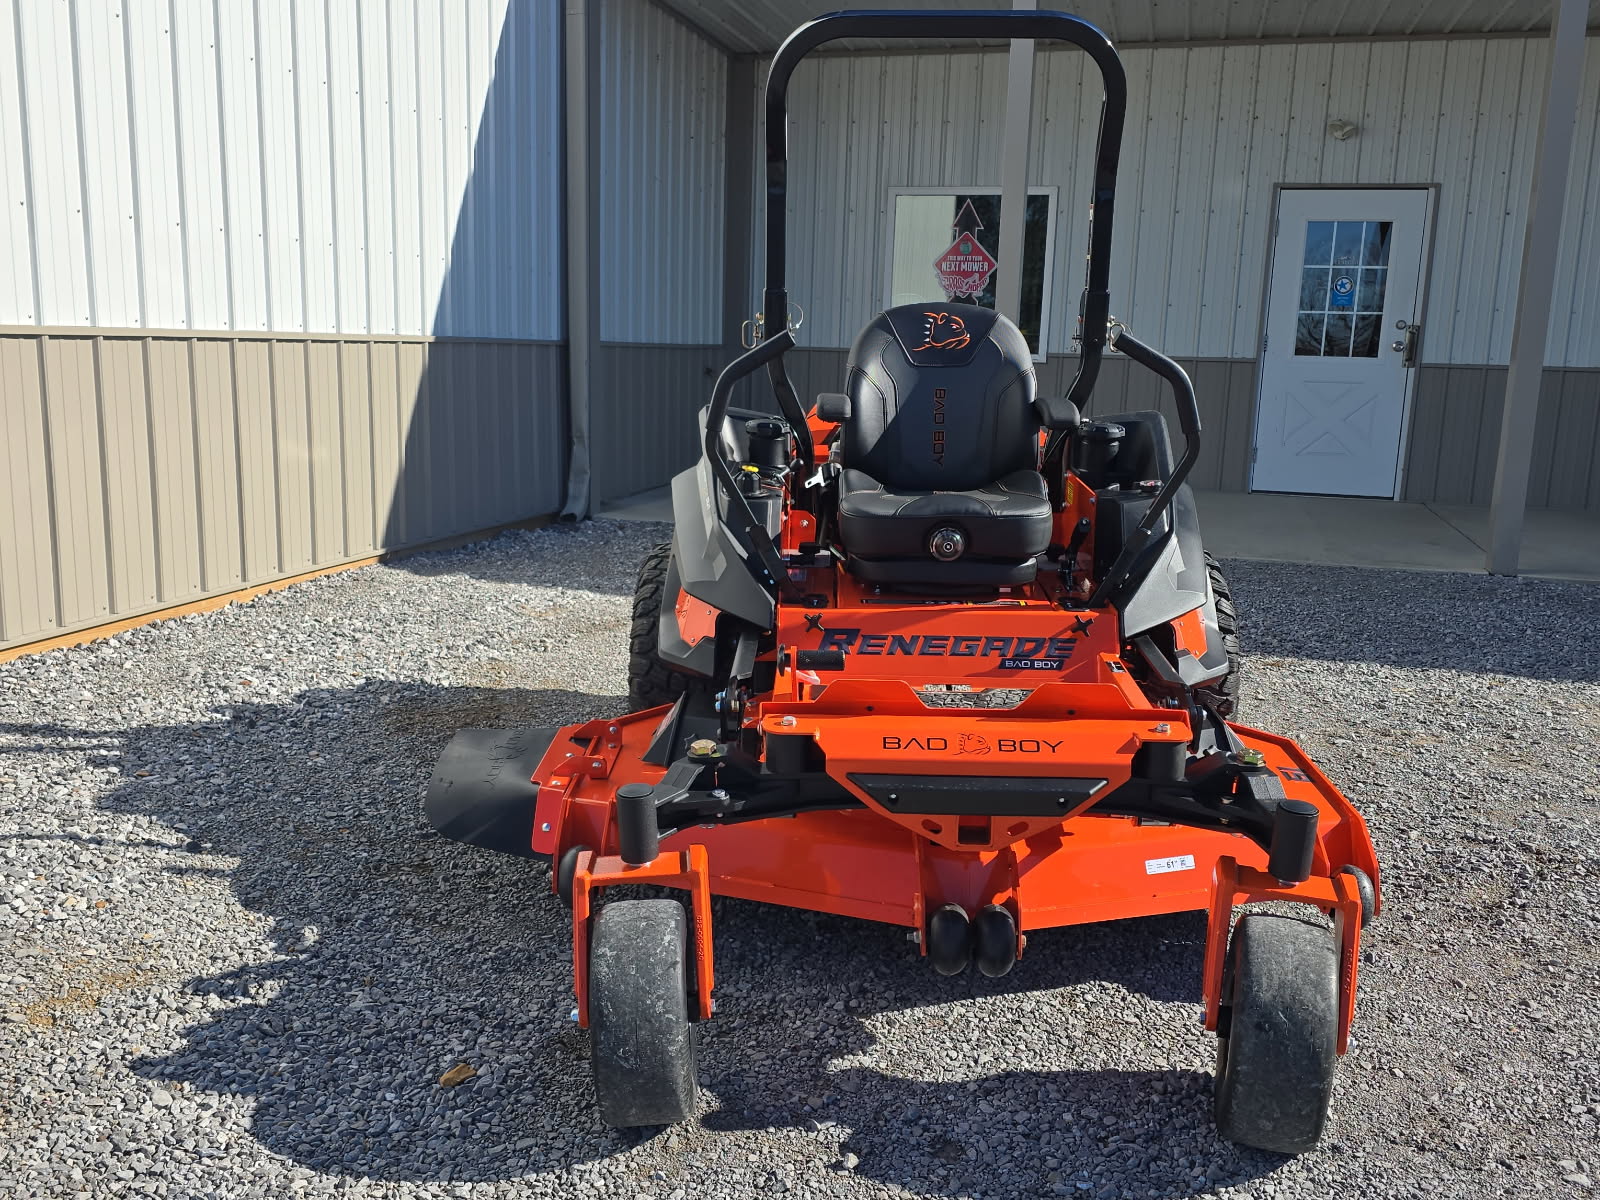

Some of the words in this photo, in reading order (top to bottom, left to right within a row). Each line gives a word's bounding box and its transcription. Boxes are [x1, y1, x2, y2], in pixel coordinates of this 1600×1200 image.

[942, 261, 960, 272] NEXT
[960, 261, 989, 272] MOWER
[933, 387, 946, 426] BAD
[932, 429, 946, 469] BOY
[1005, 660, 1031, 669] BAD
[1034, 660, 1060, 670] BOY
[882, 736, 948, 751] BAD
[998, 739, 1064, 753] BOY
